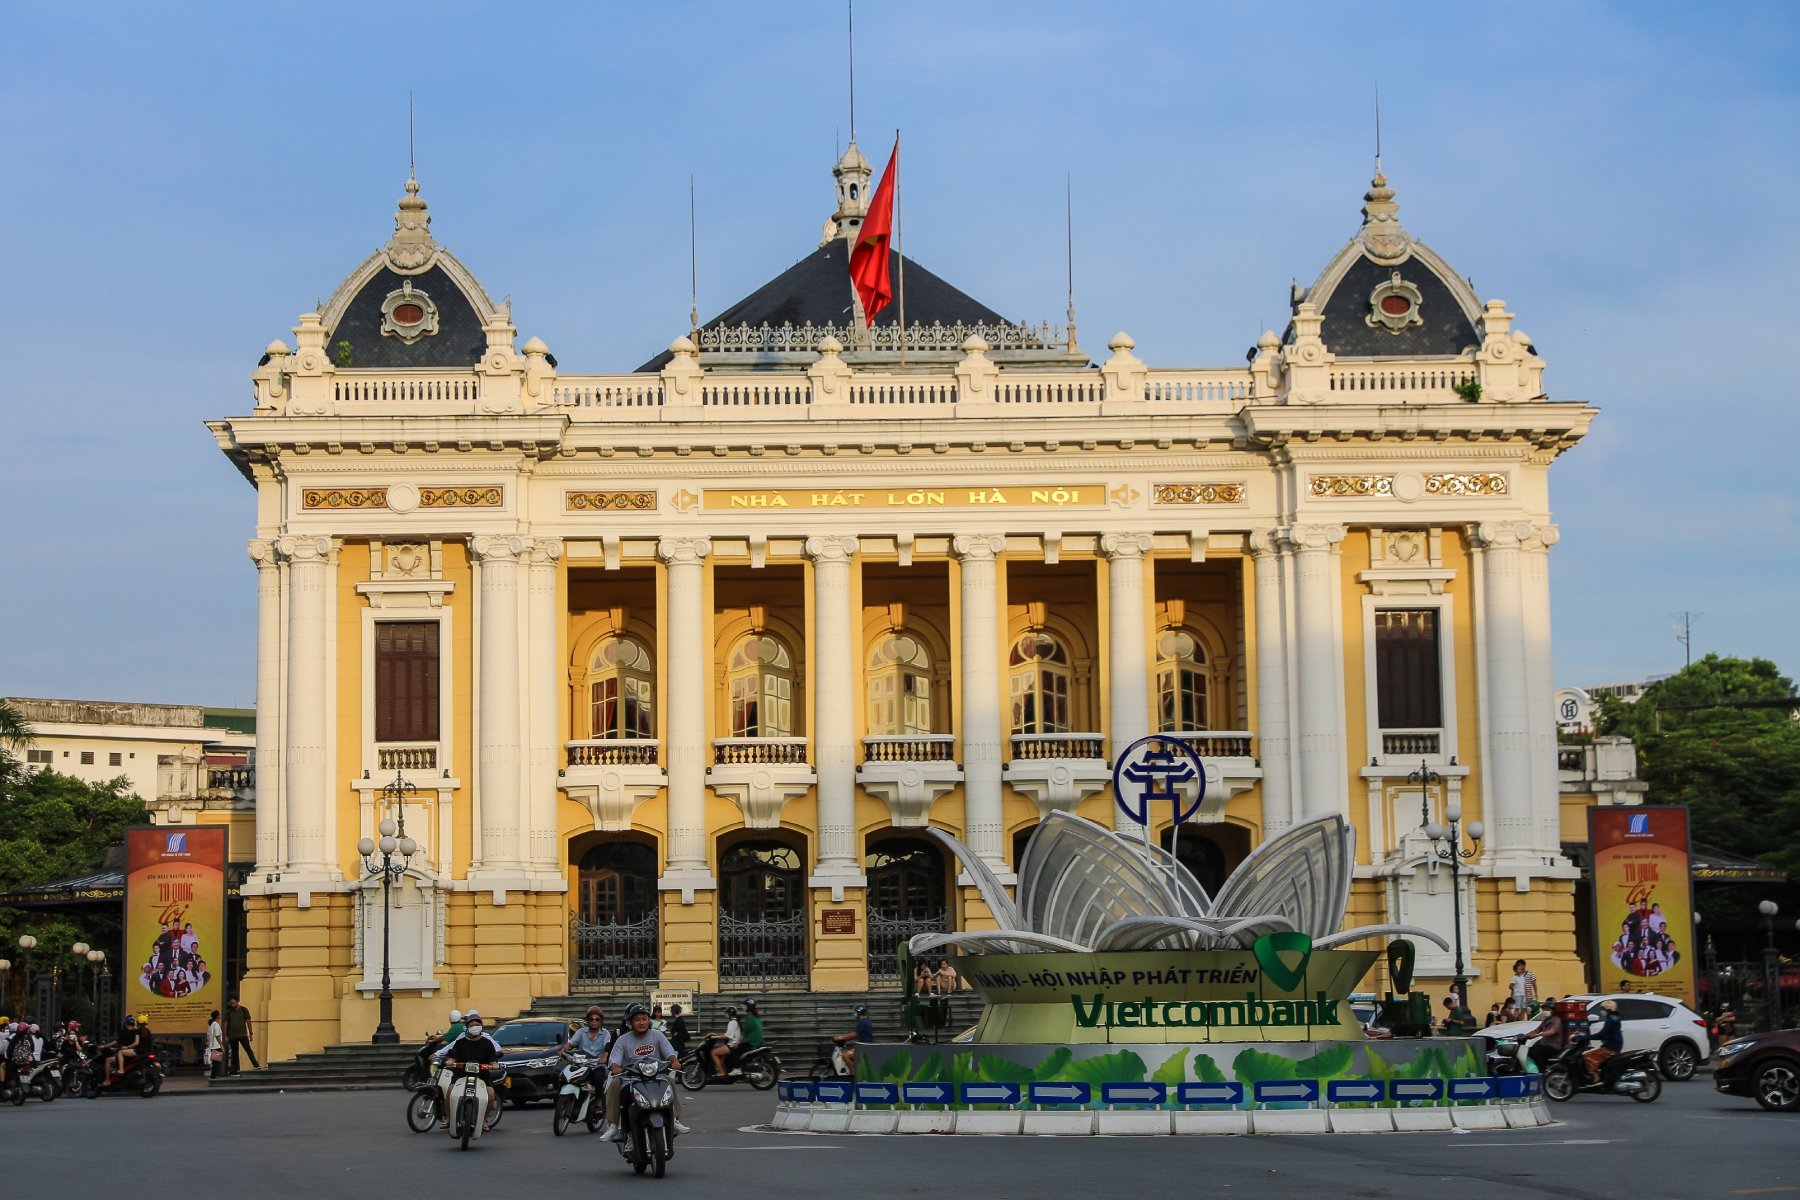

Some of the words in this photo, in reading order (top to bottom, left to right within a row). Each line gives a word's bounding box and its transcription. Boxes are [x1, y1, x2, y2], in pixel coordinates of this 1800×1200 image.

[730, 490, 789, 507] NHÀ
[811, 489, 865, 507] HÁT
[888, 488, 945, 505] LỚN
[968, 487, 1007, 504] HÀ
[1031, 486, 1080, 506] NỘI
[990, 969, 1021, 992] NỘI
[1028, 968, 1065, 991] HỘI
[1066, 967, 1127, 989] NHẬP
[1132, 965, 1192, 986] PHÁT
[1196, 962, 1258, 984] TRIỂN
[1071, 991, 1342, 1028] Vietcombank
